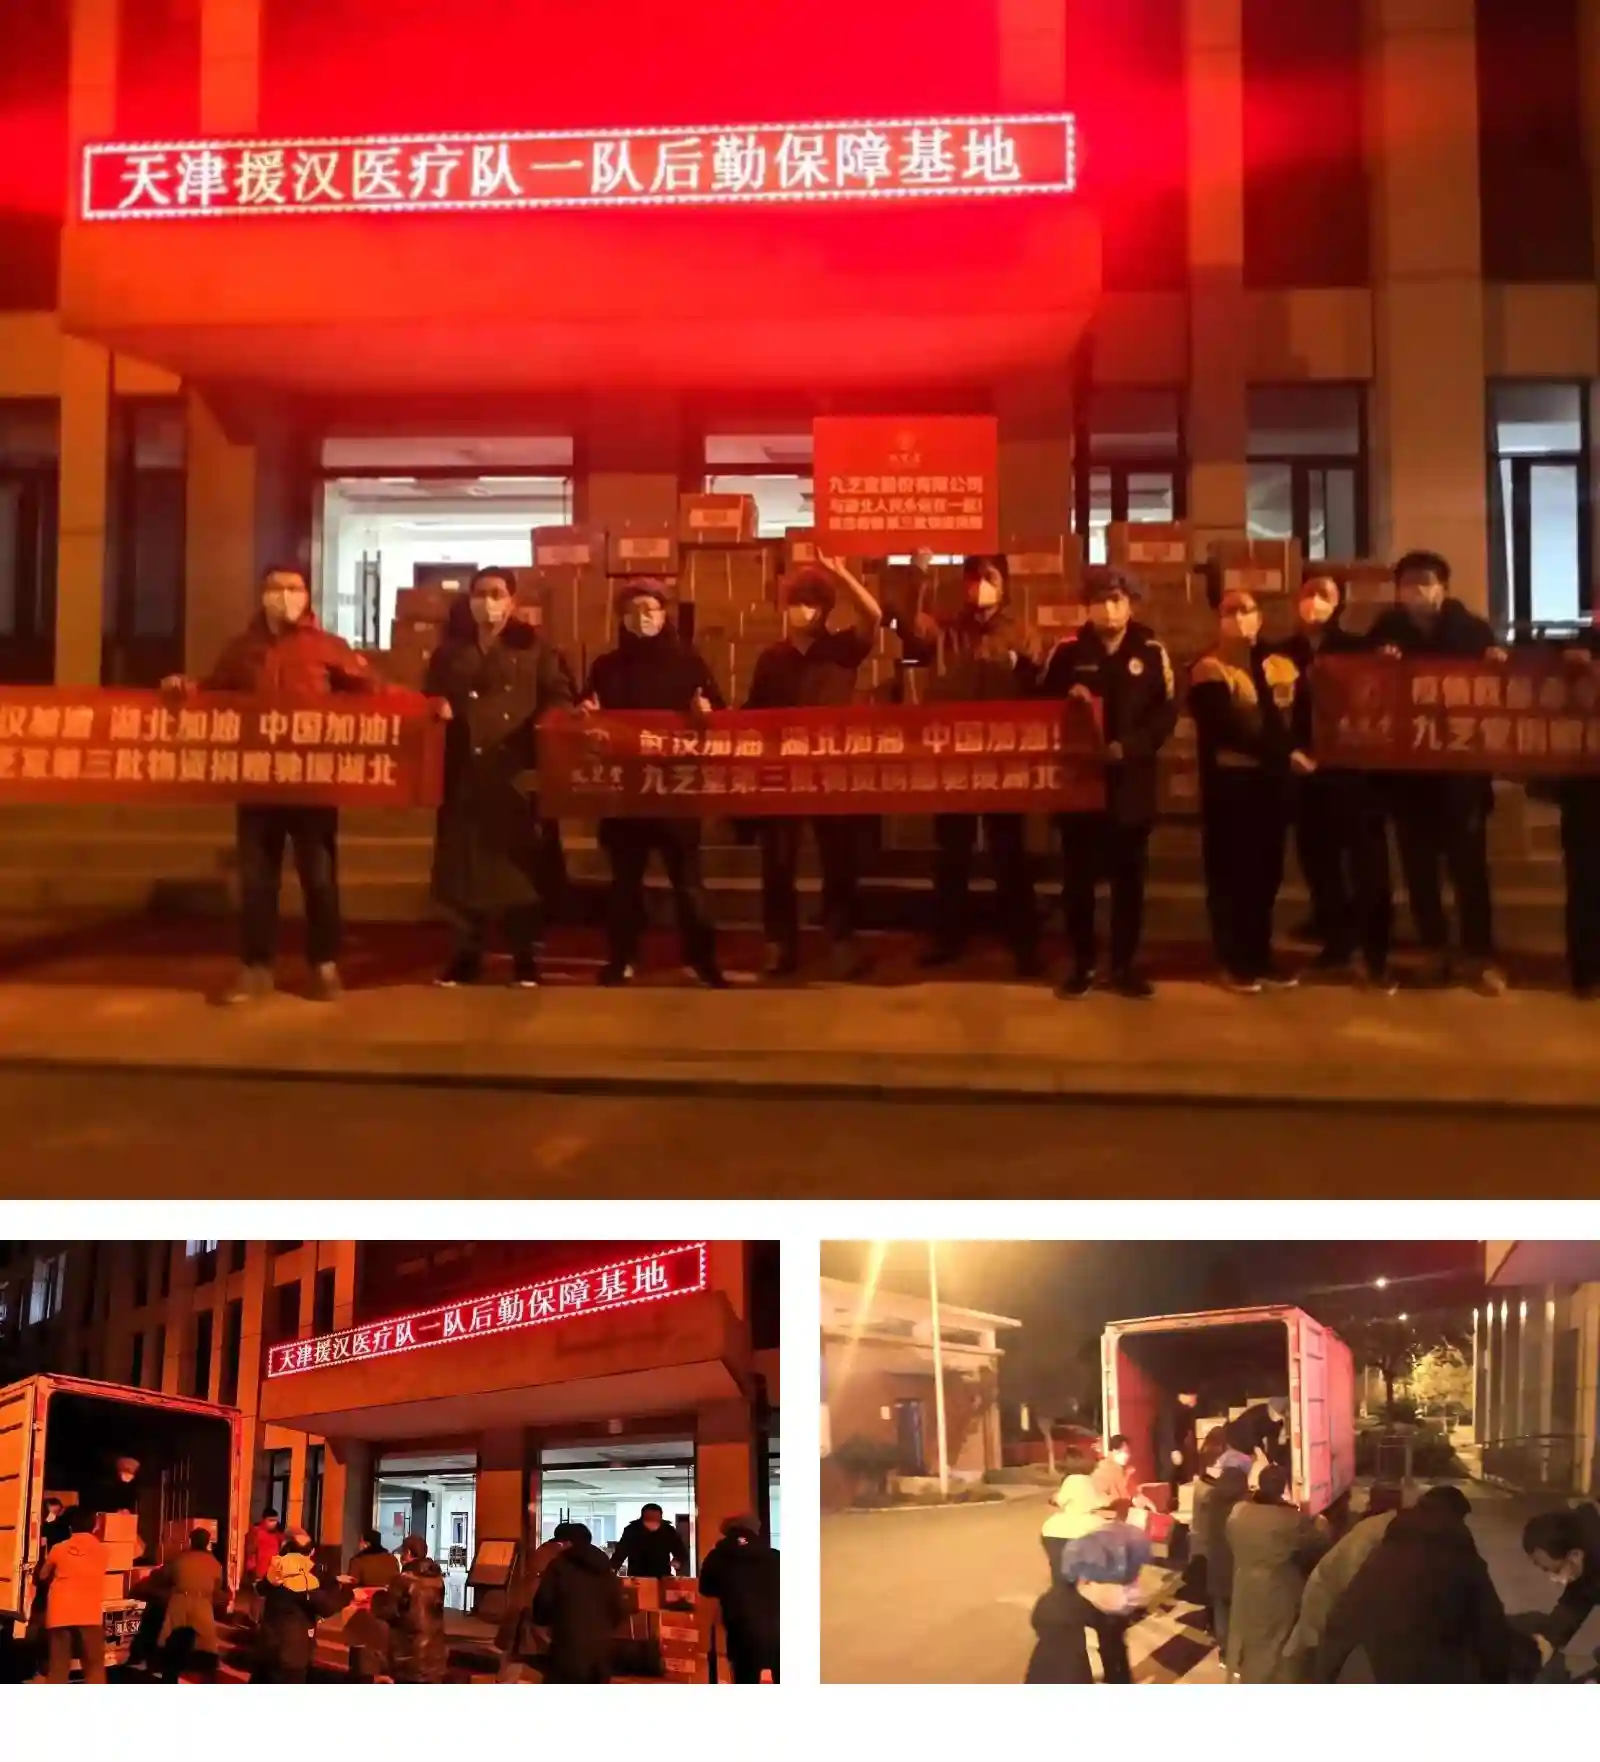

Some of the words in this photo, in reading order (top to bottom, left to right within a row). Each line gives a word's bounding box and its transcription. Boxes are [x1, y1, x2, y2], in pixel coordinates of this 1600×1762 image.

[118, 125, 1021, 209] 天津援汉医疗队一队后勤保障基地
[110, 706, 242, 744] 湖北加油
[260, 708, 400, 745] 中国加油!
[640, 728, 764, 757] 武汉加油
[780, 726, 904, 756] 湖北加油
[922, 721, 1062, 754] 中国加油!
[279, 1259, 668, 1371] 天津援汉医疗队一队后勤保障基地
